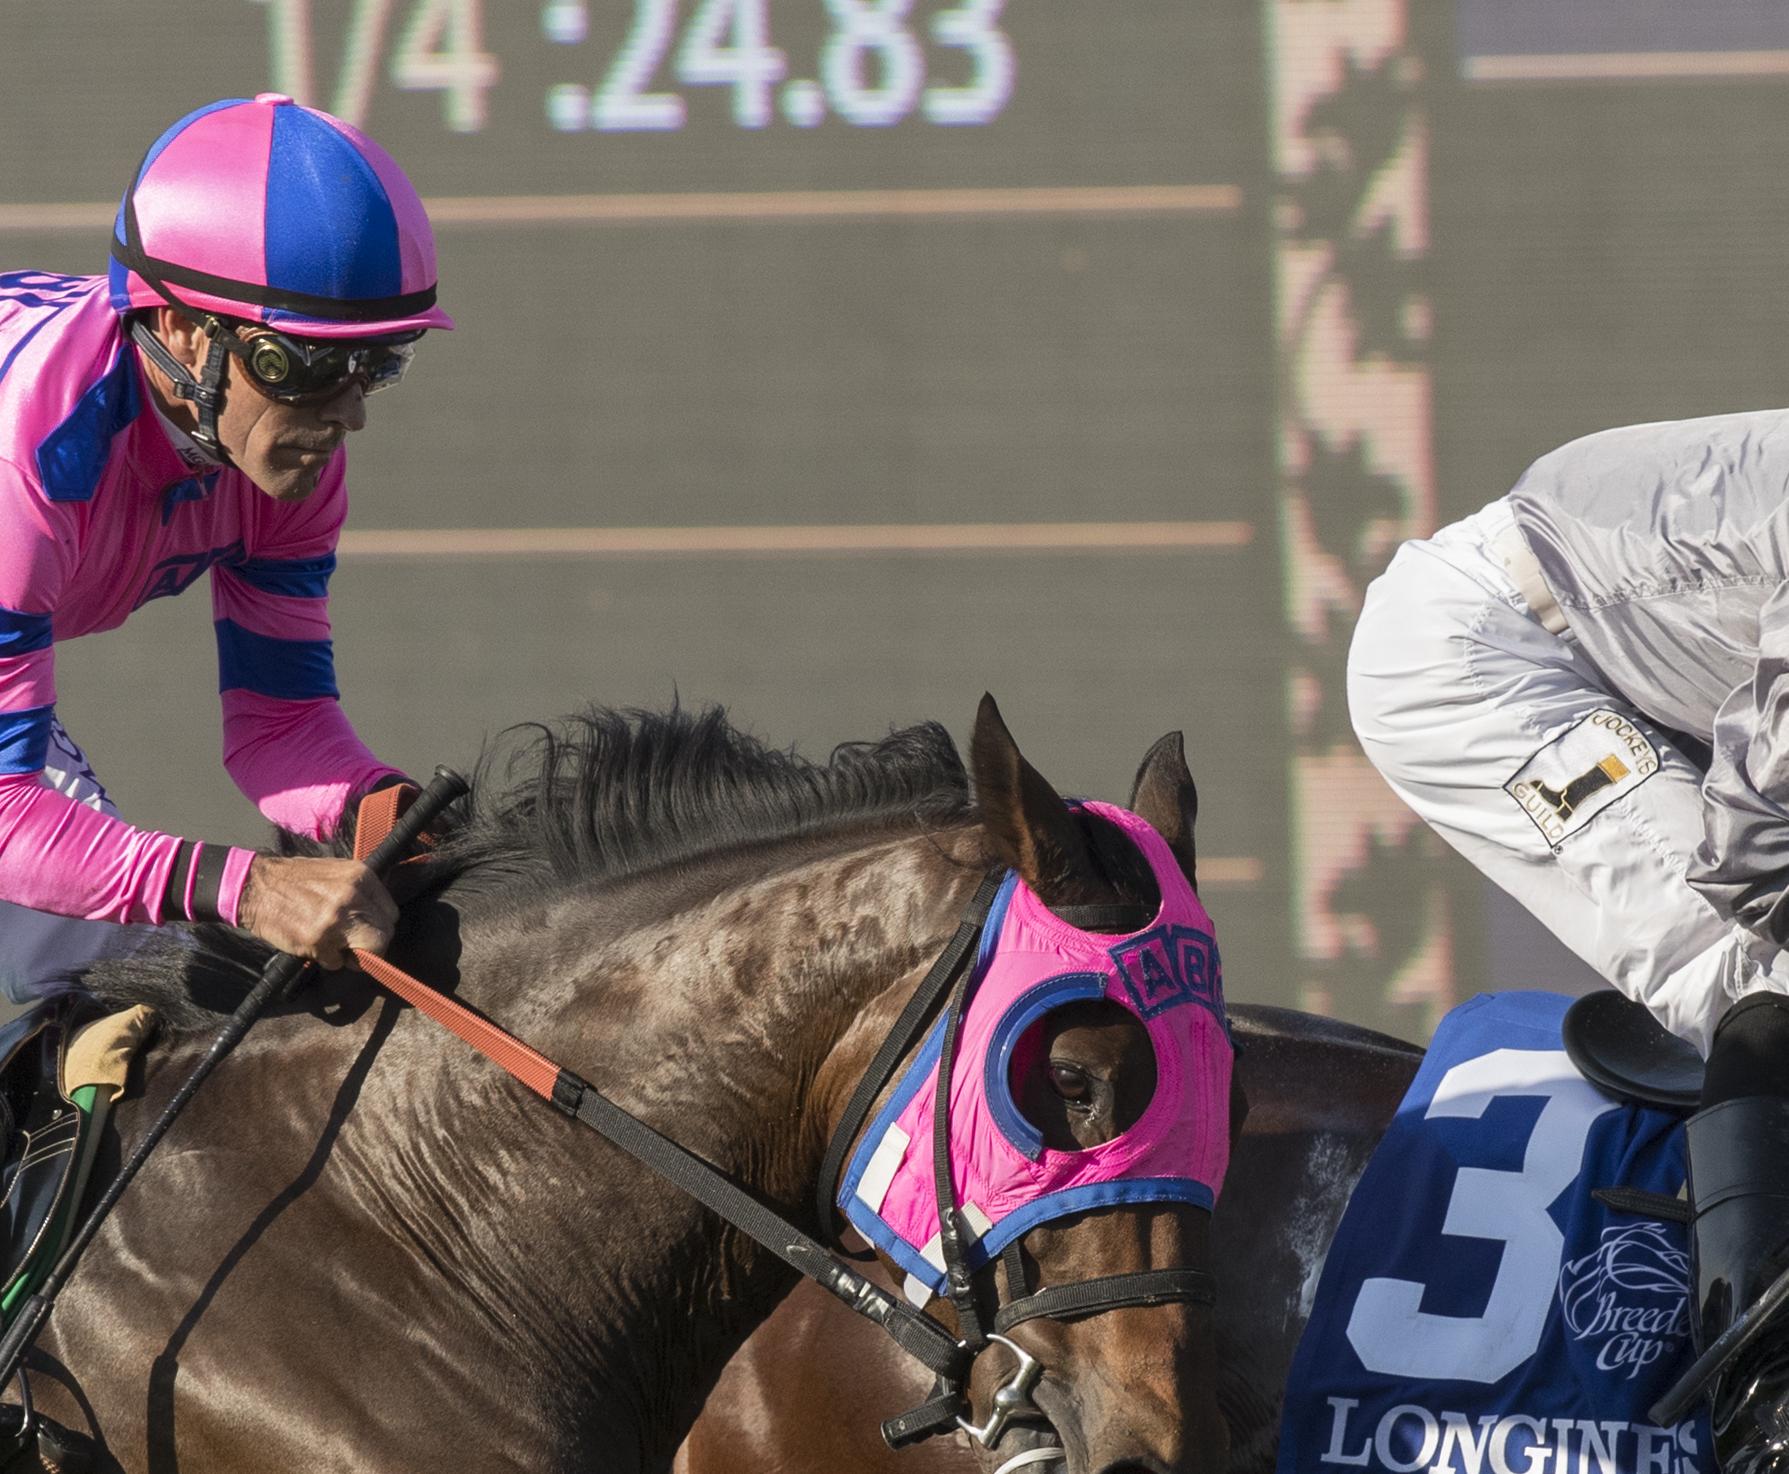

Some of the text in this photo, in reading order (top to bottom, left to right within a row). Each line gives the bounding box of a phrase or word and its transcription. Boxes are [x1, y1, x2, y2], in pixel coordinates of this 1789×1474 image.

[1591, 713, 1657, 776] JOCKEYS
[1511, 781, 1565, 840] GUILD
[1345, 1047, 1624, 1386] 3
[1595, 1331, 1663, 1381] Cup
